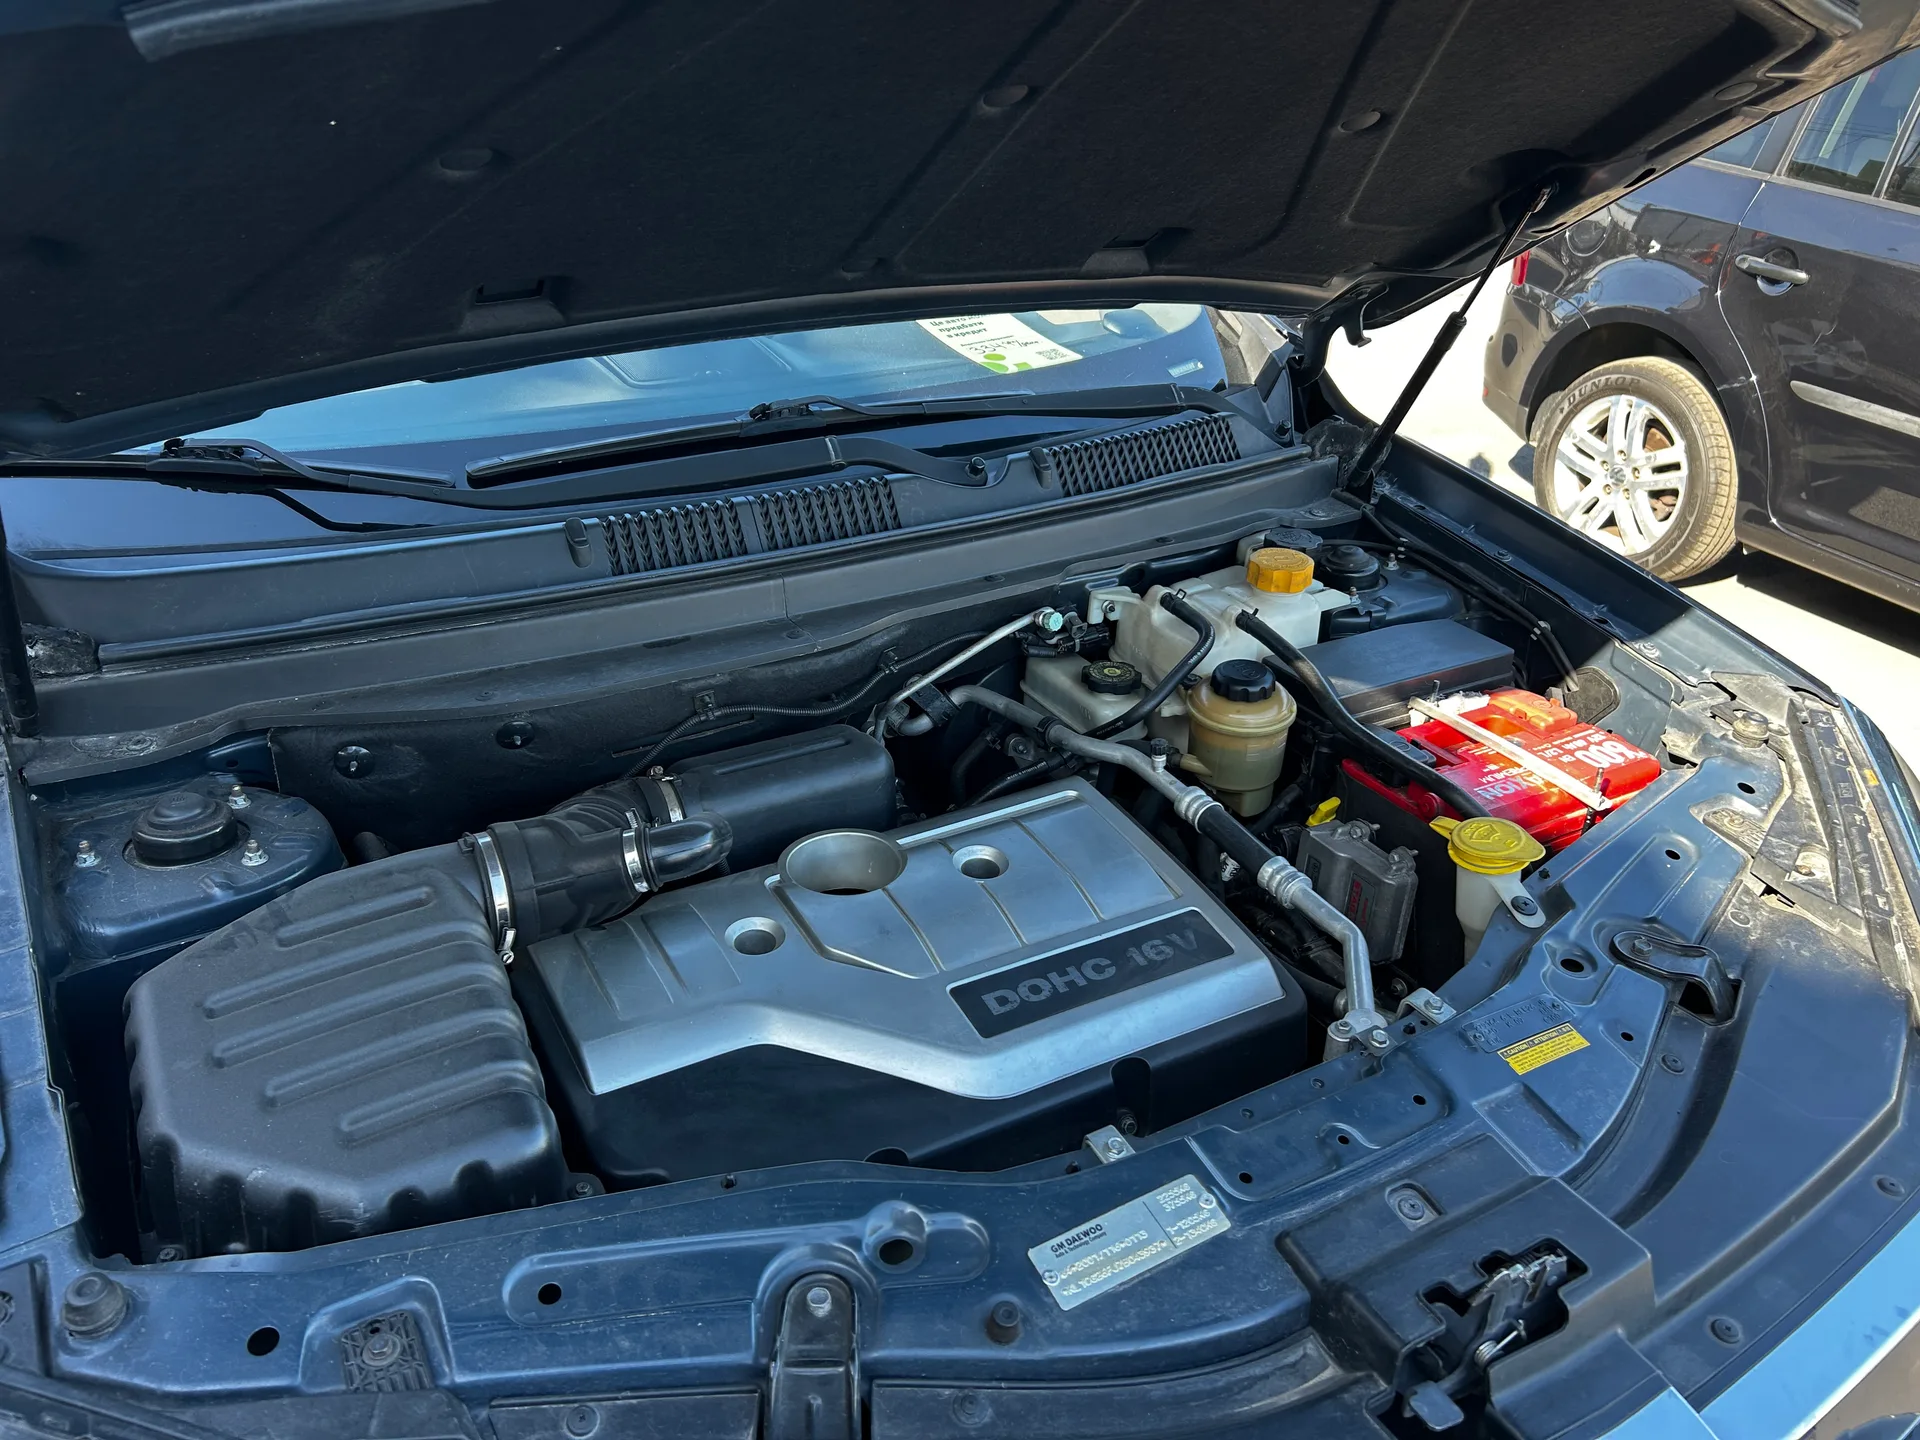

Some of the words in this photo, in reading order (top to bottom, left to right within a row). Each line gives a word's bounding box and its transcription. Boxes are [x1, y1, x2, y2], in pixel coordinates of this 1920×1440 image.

[1566, 376, 1641, 408] DUNLOP
[1573, 740, 1637, 769] 600
[1477, 770, 1545, 800] AXION
[980, 957, 1116, 1016] DOHC
[1126, 928, 1199, 968] 16V
[1051, 1242, 1066, 1254] GM
[1066, 1223, 1104, 1248] DAEWOO
